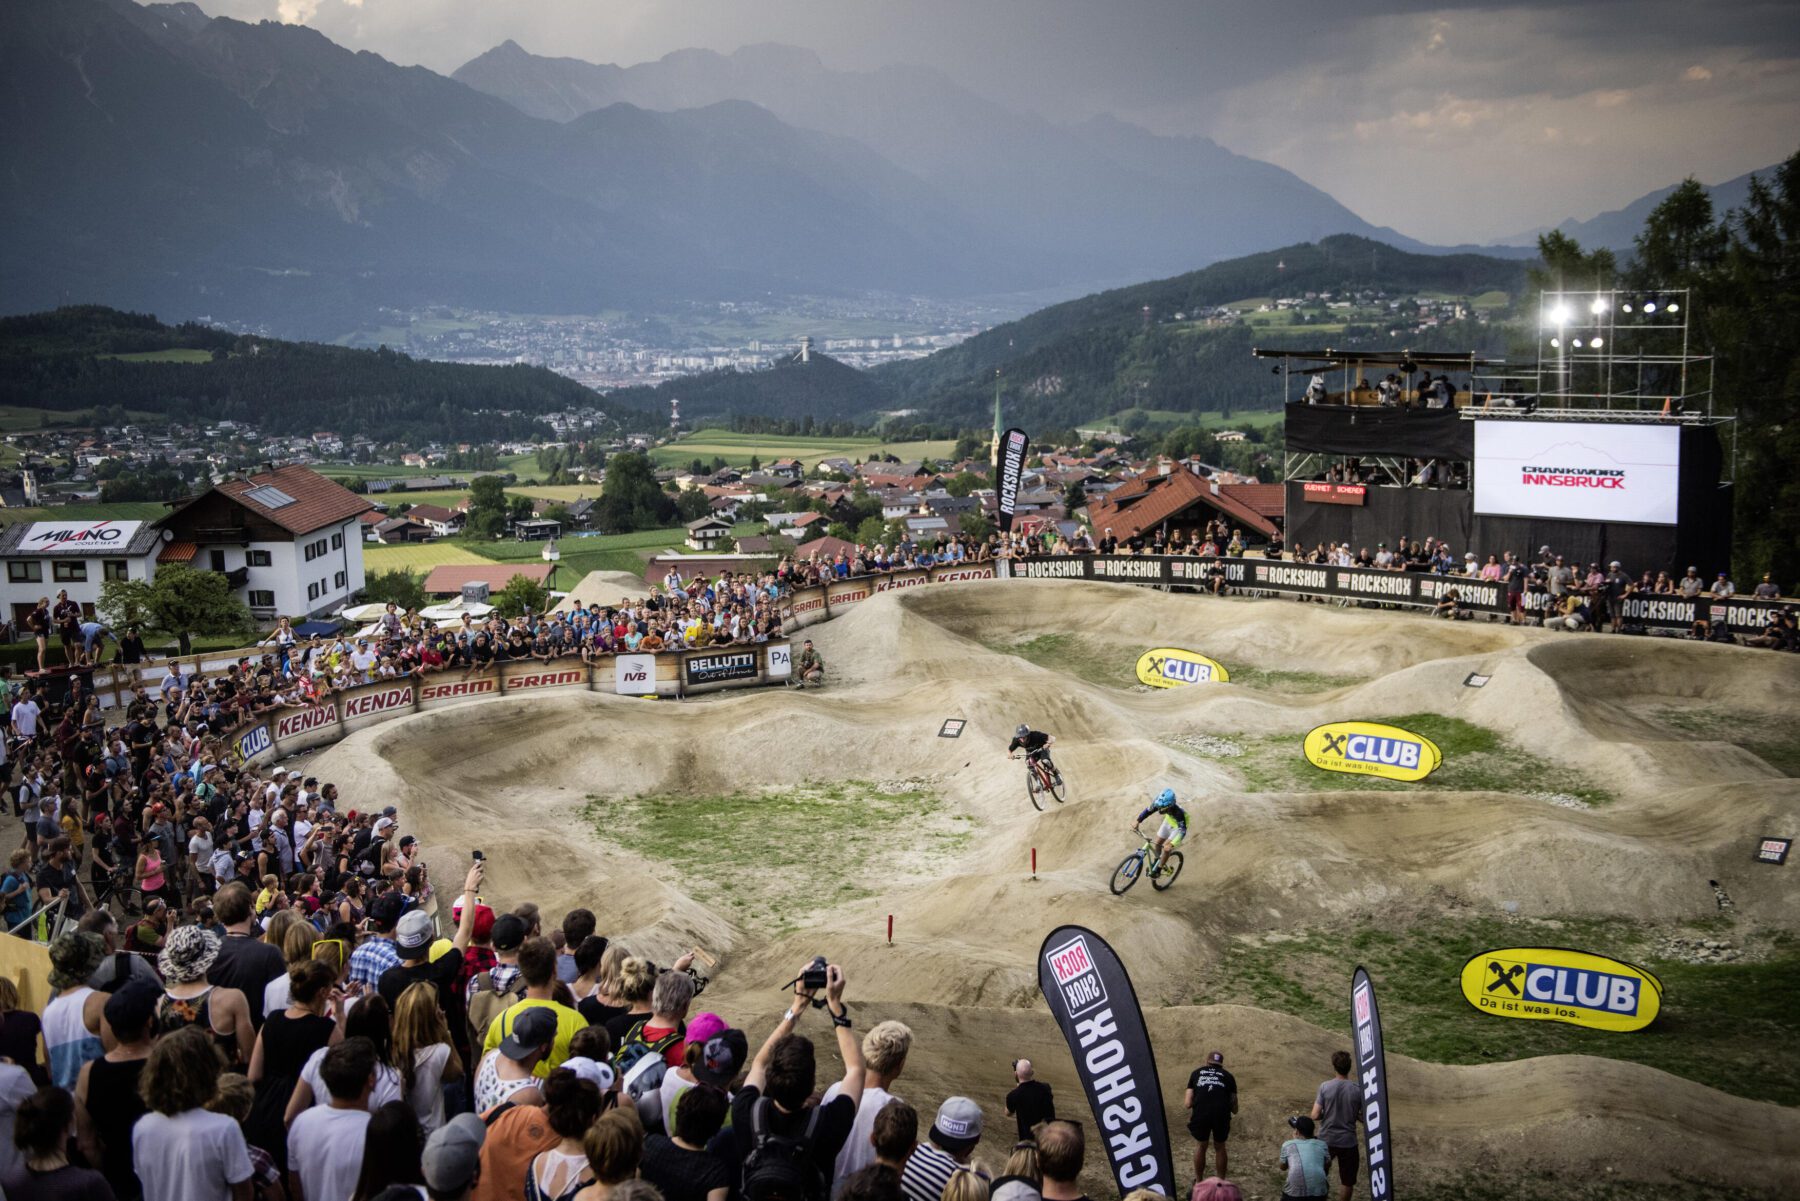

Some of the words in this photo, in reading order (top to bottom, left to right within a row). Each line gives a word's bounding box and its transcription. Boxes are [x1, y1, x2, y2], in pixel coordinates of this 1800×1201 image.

[1522, 466, 1625, 477] CRANKWORX
[1000, 452, 1021, 514] ROCKSHOX
[1523, 474, 1625, 489] INNSBRUCK
[30, 529, 122, 541] MILANO
[1028, 561, 1084, 578] ROCKSHOX
[1106, 560, 1160, 577] ROCKSHOX
[1269, 567, 1327, 588] ROCKSHOX
[1351, 574, 1411, 595] ROCKSHOX
[794, 599, 822, 613] SRAM
[830, 591, 866, 605] SRAM
[1622, 599, 1695, 621] ROCKSHOX
[690, 653, 753, 672] BELLUTTI
[1164, 659, 1210, 682] CLUB
[508, 671, 581, 688] SRAM
[624, 672, 647, 681] IVB
[422, 680, 493, 699] SRAM
[345, 687, 412, 717] KENDA
[278, 704, 336, 738] KENDA
[242, 726, 270, 759] CLUB
[1348, 736, 1418, 767] CLUB
[1317, 757, 1328, 765] Da
[1331, 759, 1342, 767] ist
[1345, 762, 1362, 770] was
[1526, 967, 1636, 1012] CLUB
[1480, 997, 1497, 1009] Da
[1502, 998, 1518, 1011] ist
[1524, 1004, 1550, 1014] was
[1555, 1007, 1580, 1019] los.
